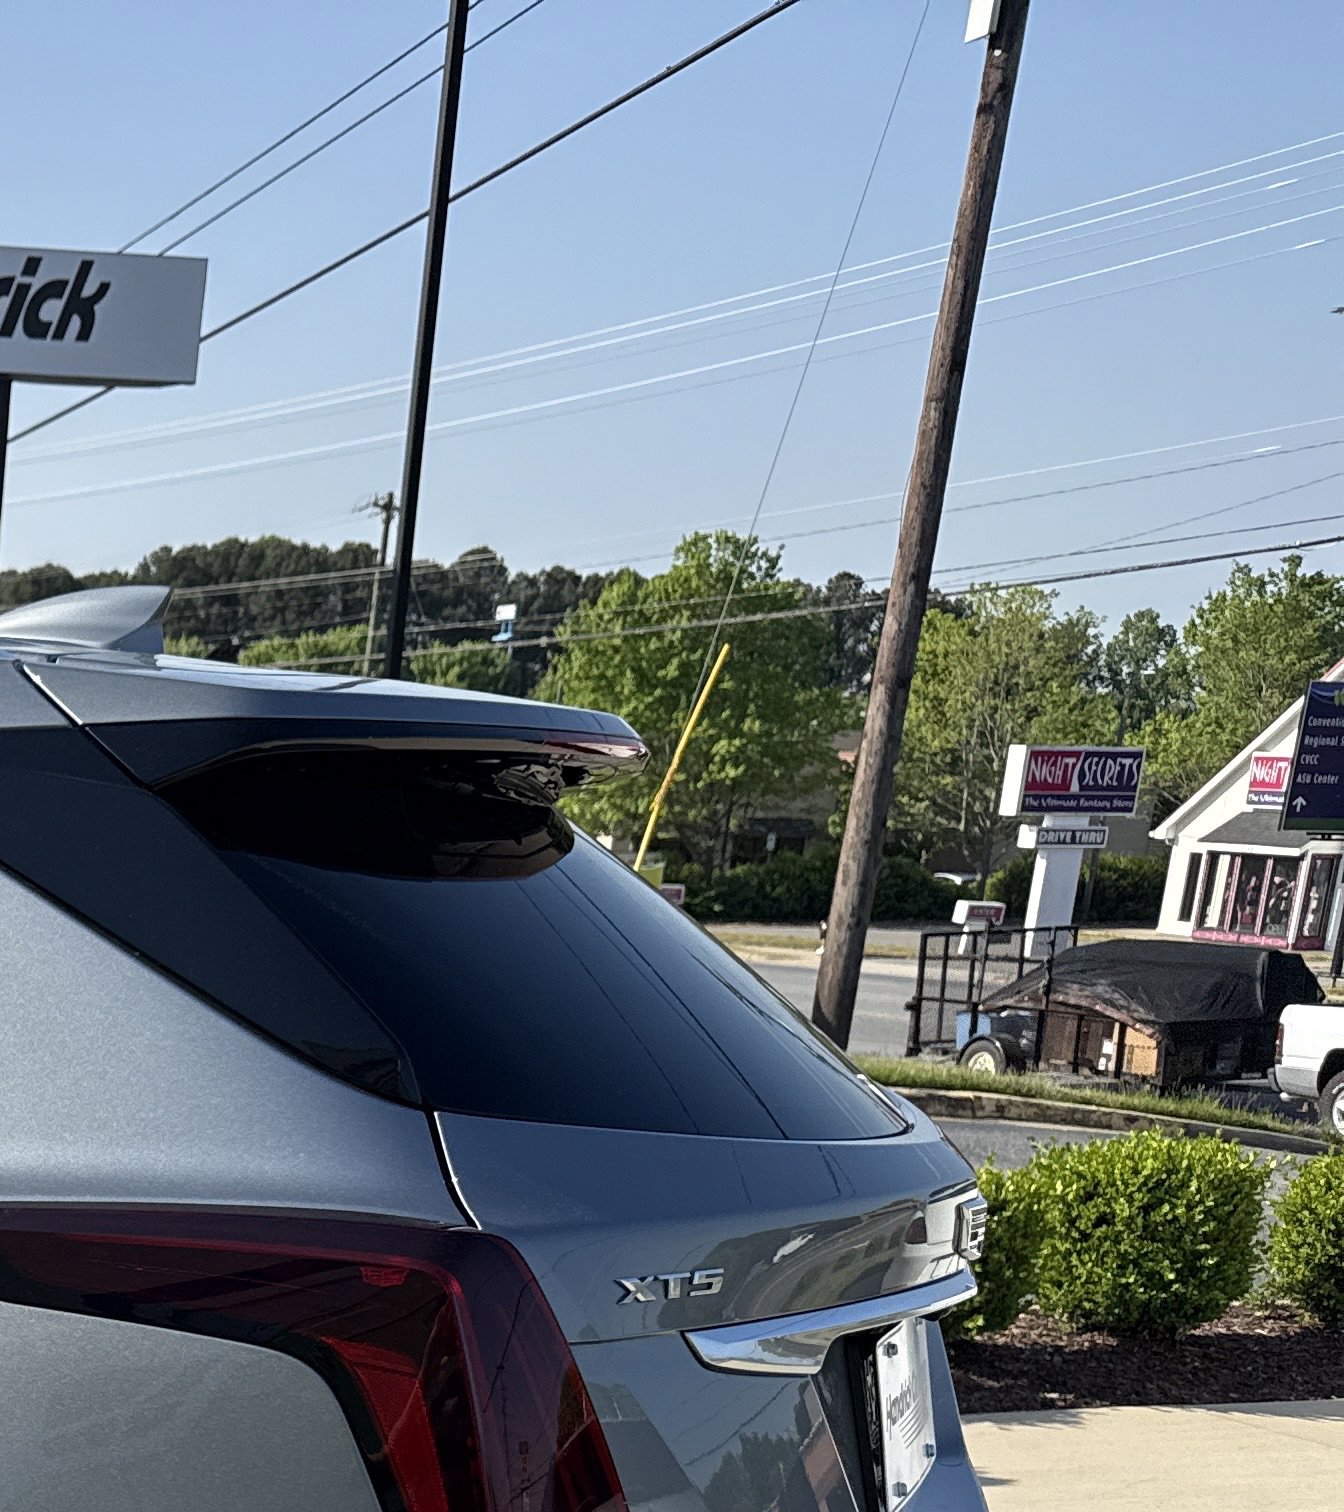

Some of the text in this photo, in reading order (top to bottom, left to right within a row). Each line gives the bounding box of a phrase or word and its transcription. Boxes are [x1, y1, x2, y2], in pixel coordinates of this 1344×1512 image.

[1303, 735, 1339, 748] Regional
[1300, 753, 1320, 765] CVCC
[1081, 756, 1141, 787] SECRETS
[1313, 773, 1339, 785] Center
[1038, 831, 1104, 843] DRIVE THRU
[614, 1267, 725, 1304] XT5
